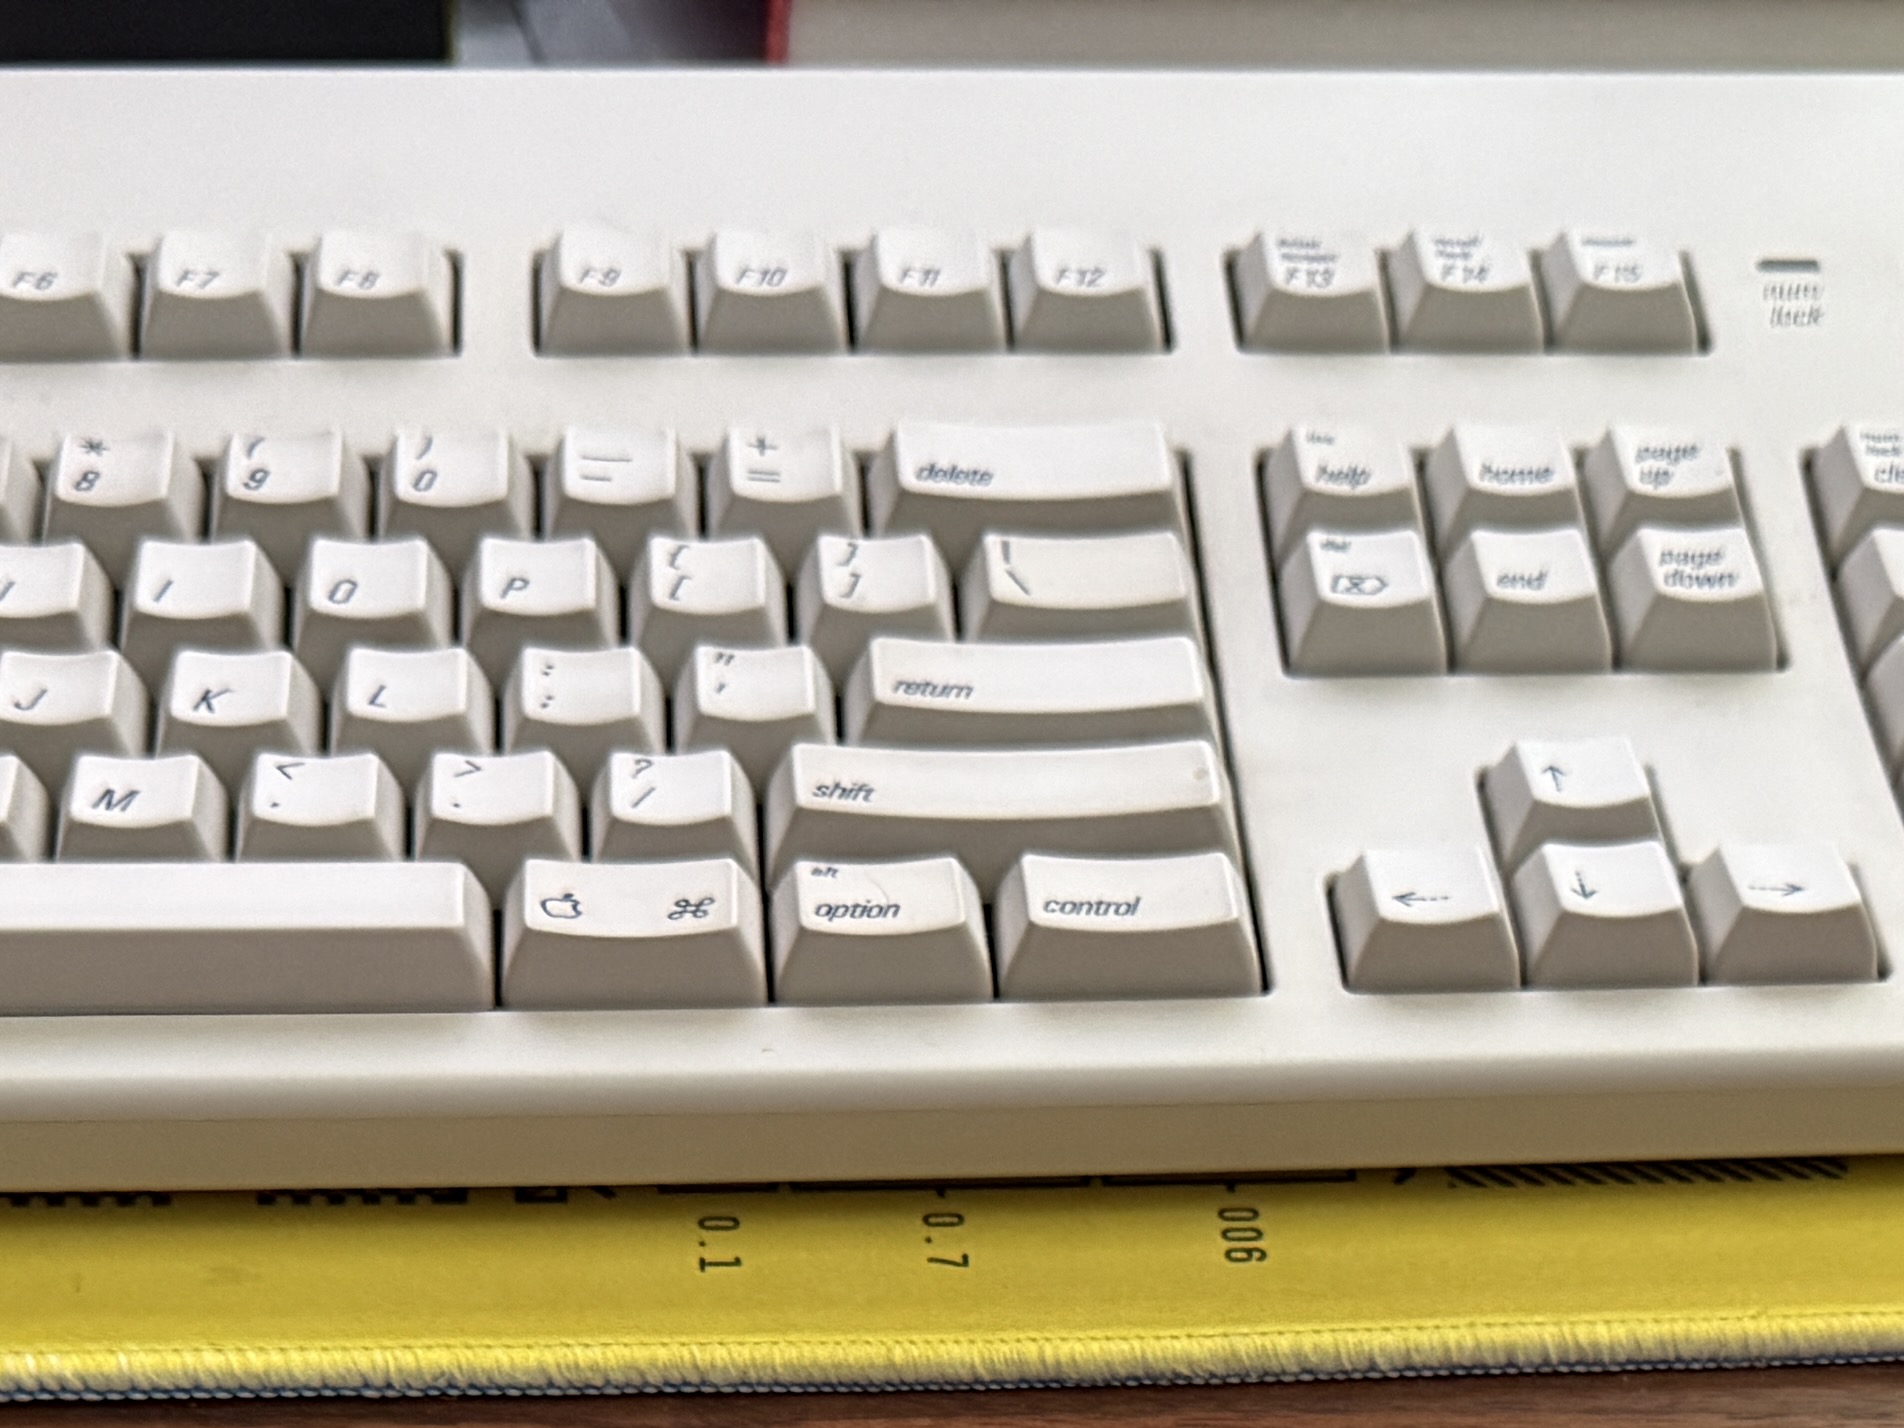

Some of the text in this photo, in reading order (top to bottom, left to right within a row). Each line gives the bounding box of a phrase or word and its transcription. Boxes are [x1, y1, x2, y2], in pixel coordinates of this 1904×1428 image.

[915, 462, 994, 486] delete
[892, 679, 974, 700] return
[812, 781, 875, 802] shift
[814, 899, 901, 922] option
[1042, 895, 1142, 917] control
[922, 1213, 971, 1268] 0.7
